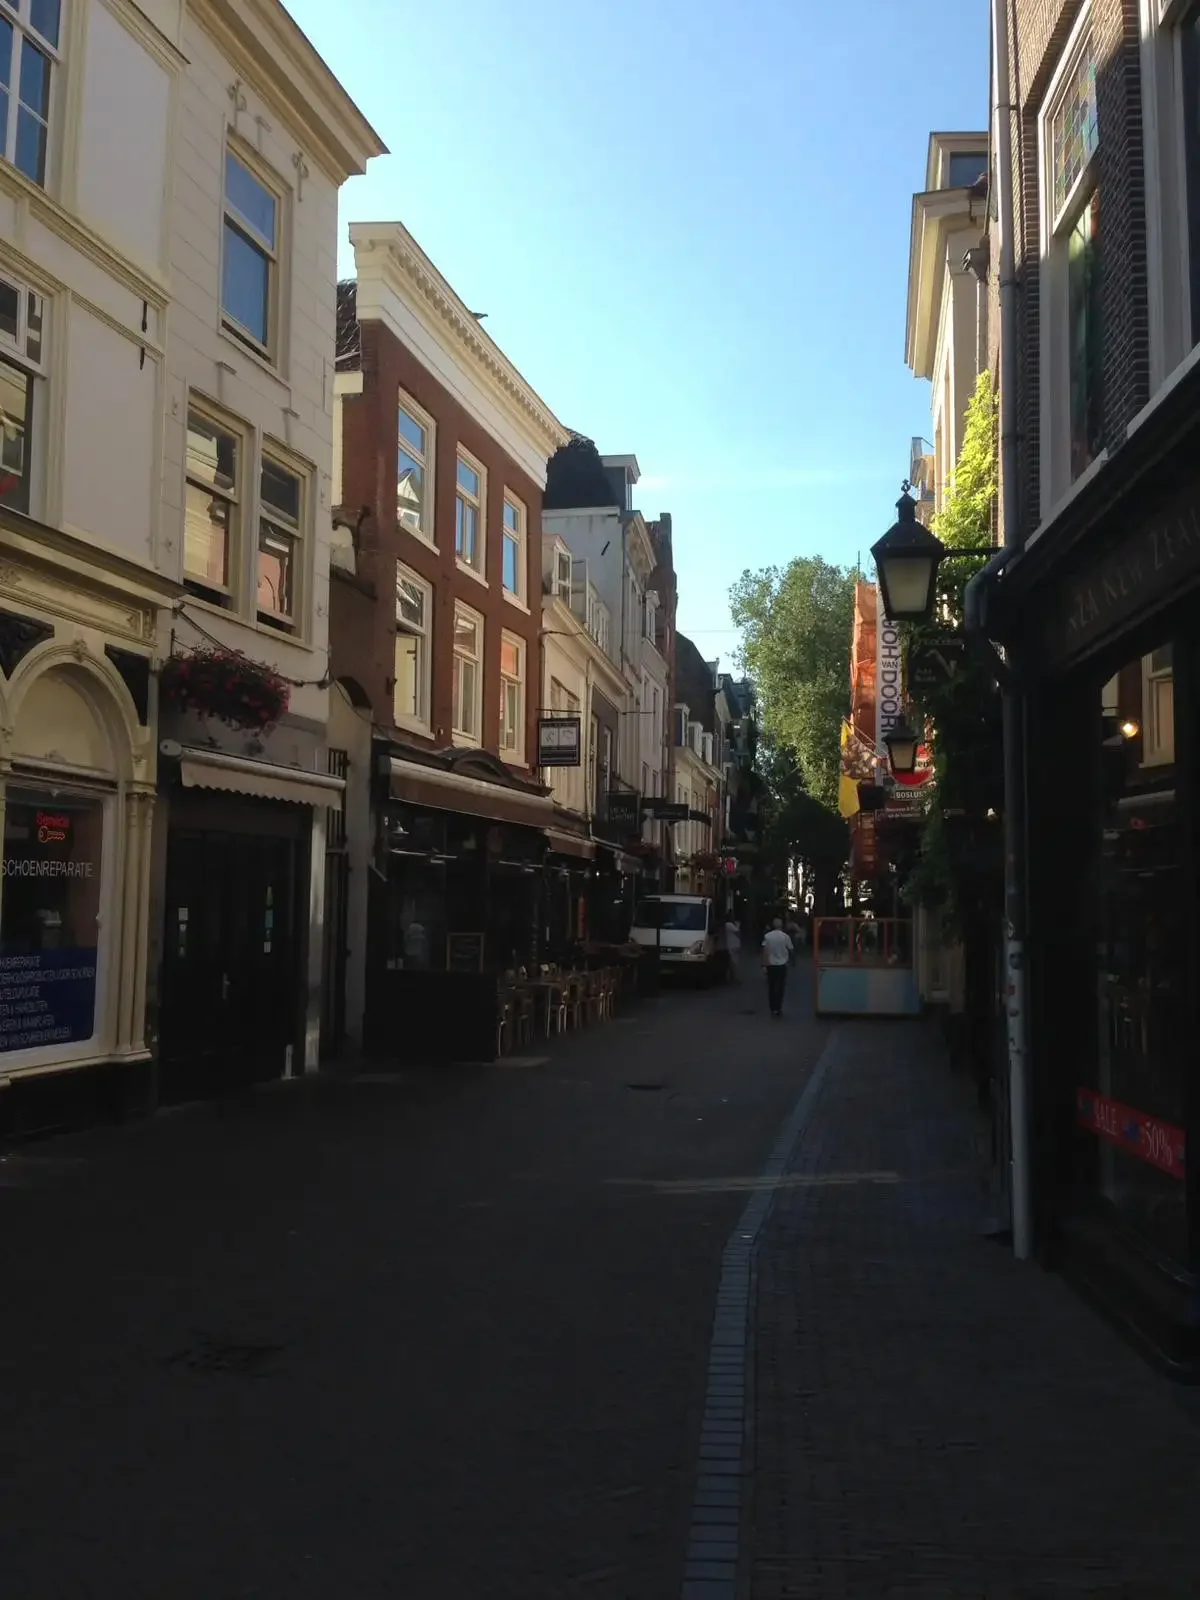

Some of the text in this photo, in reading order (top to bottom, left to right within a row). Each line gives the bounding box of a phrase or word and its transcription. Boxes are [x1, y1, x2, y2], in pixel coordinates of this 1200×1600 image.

[881, 660, 898, 669] VAN
[1, 859, 94, 878] SCHOENREPARATIE
[1093, 1098, 1118, 1137] SALE
